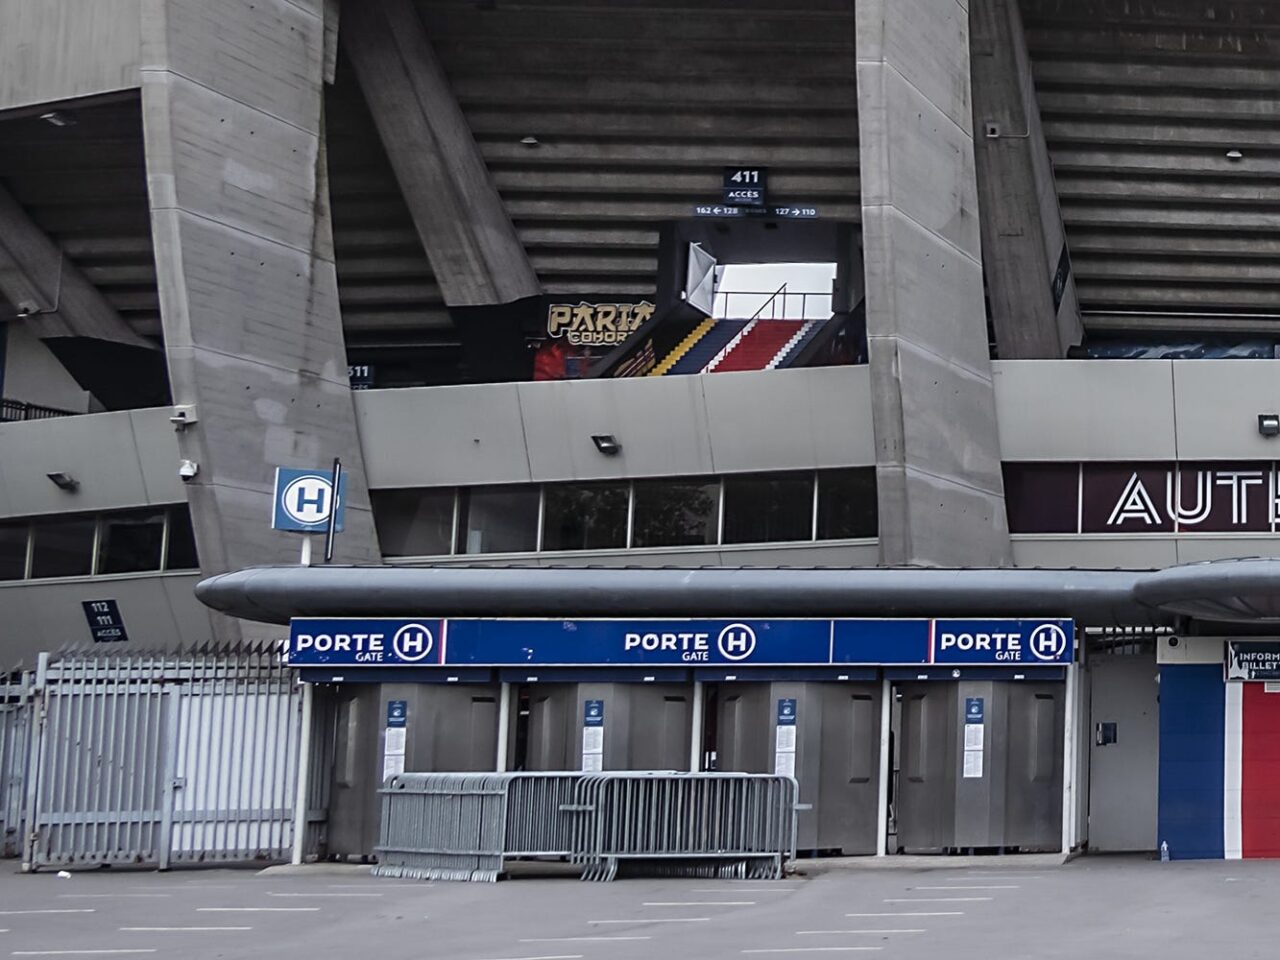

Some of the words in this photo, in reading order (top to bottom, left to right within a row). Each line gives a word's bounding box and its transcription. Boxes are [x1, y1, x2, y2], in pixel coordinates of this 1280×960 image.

[731, 171, 758, 183] 411
[728, 190, 759, 198] ACCÈS
[568, 331, 630, 346] COHOR
[91, 602, 109, 612] 112
[96, 615, 113, 625] 111
[296, 633, 384, 652] PORTE
[624, 633, 709, 651] PORTE
[940, 633, 1022, 651] PORTE
[355, 651, 384, 662] GATE
[682, 651, 709, 661] GATE
[995, 650, 1022, 661] GATE
